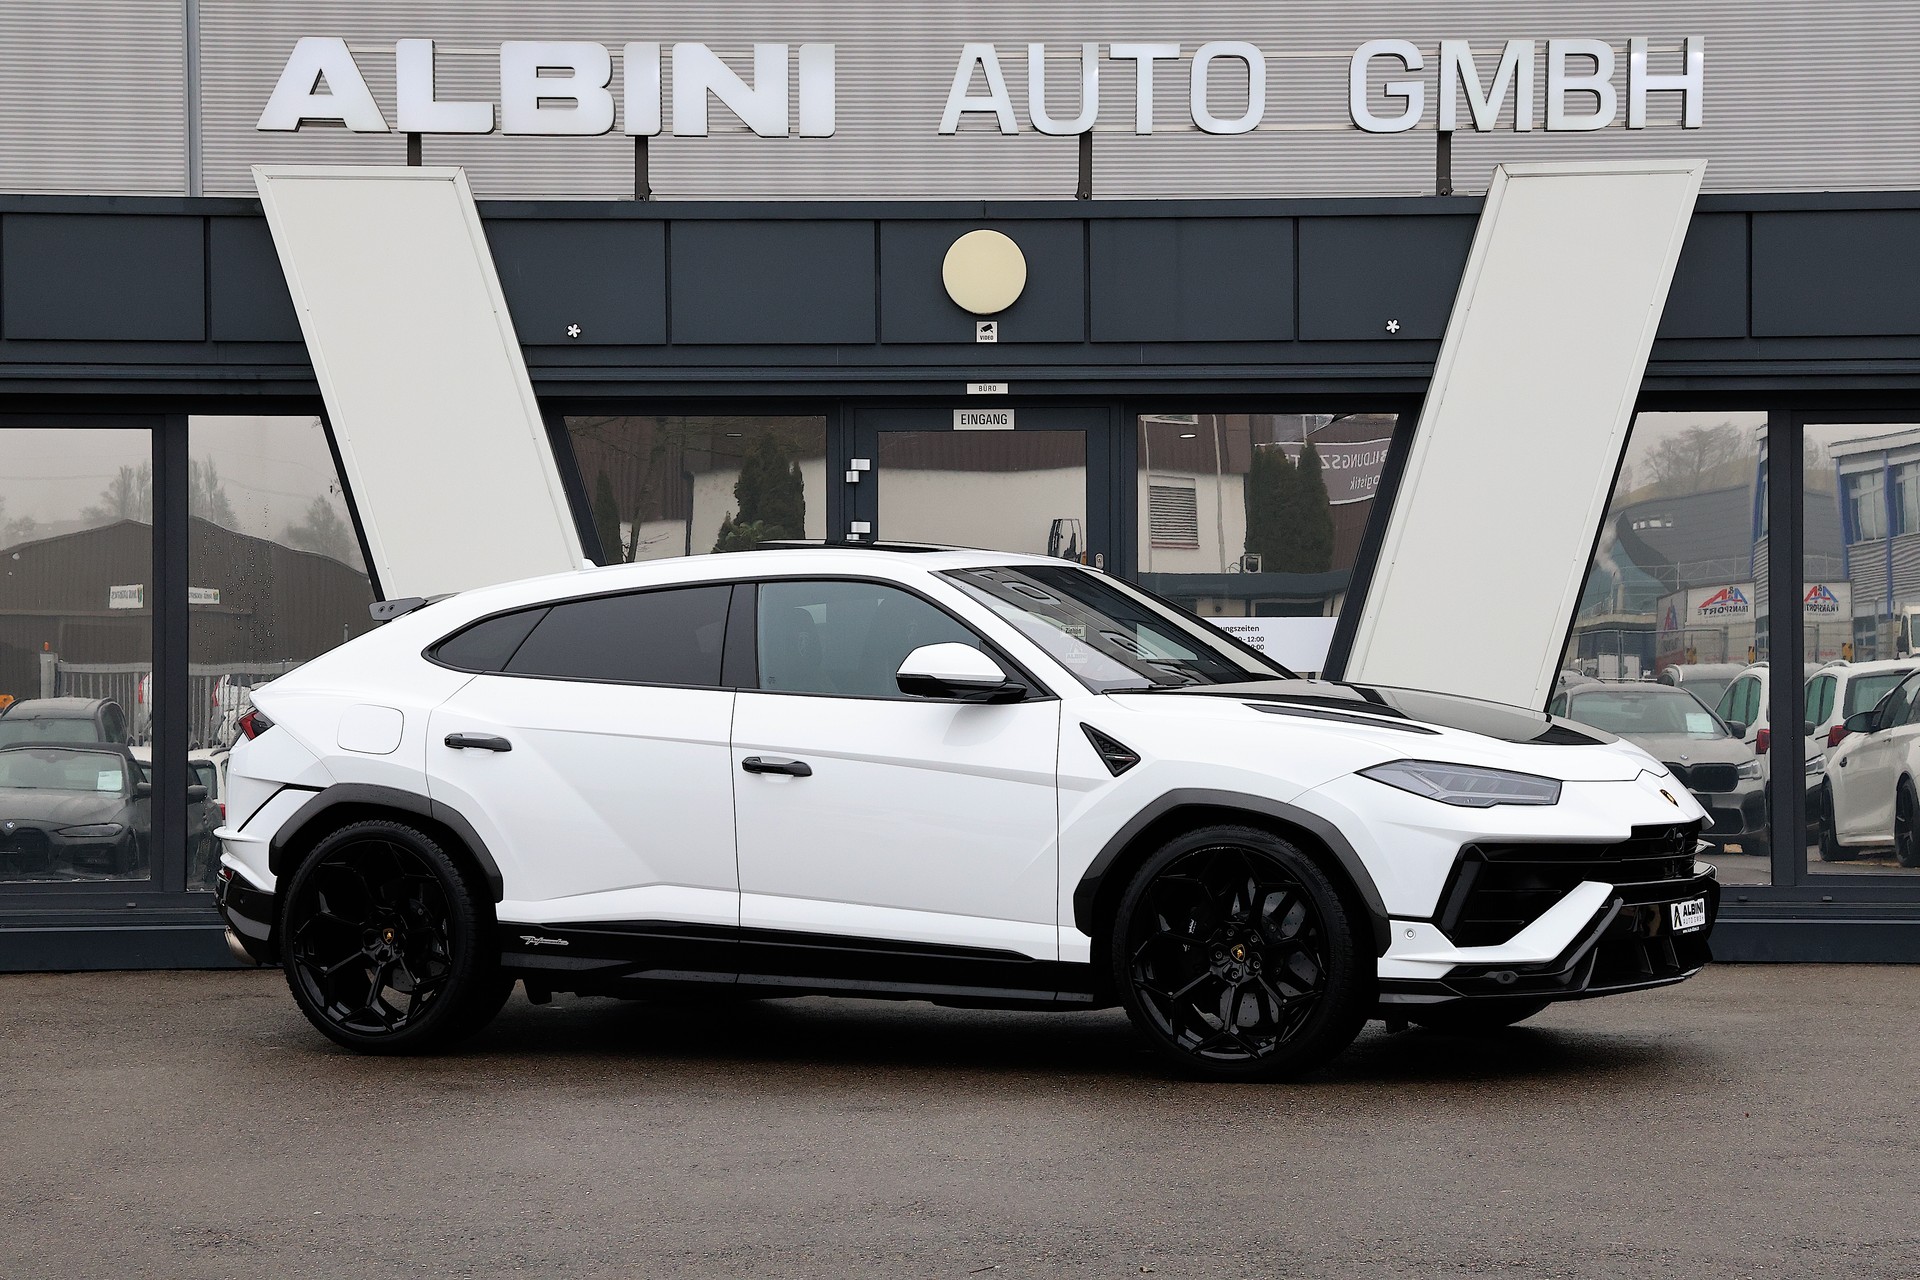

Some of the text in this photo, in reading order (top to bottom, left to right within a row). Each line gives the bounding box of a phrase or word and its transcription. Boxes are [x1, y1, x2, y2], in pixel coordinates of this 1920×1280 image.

[255, 36, 1706, 138] ALBINI AUTO GMBH
[978, 384, 997, 392] BÜRO
[960, 413, 1008, 425] EINGANG
[1221, 624, 1260, 633] ungszeiten
[1683, 902, 1703, 916] ALBINI
